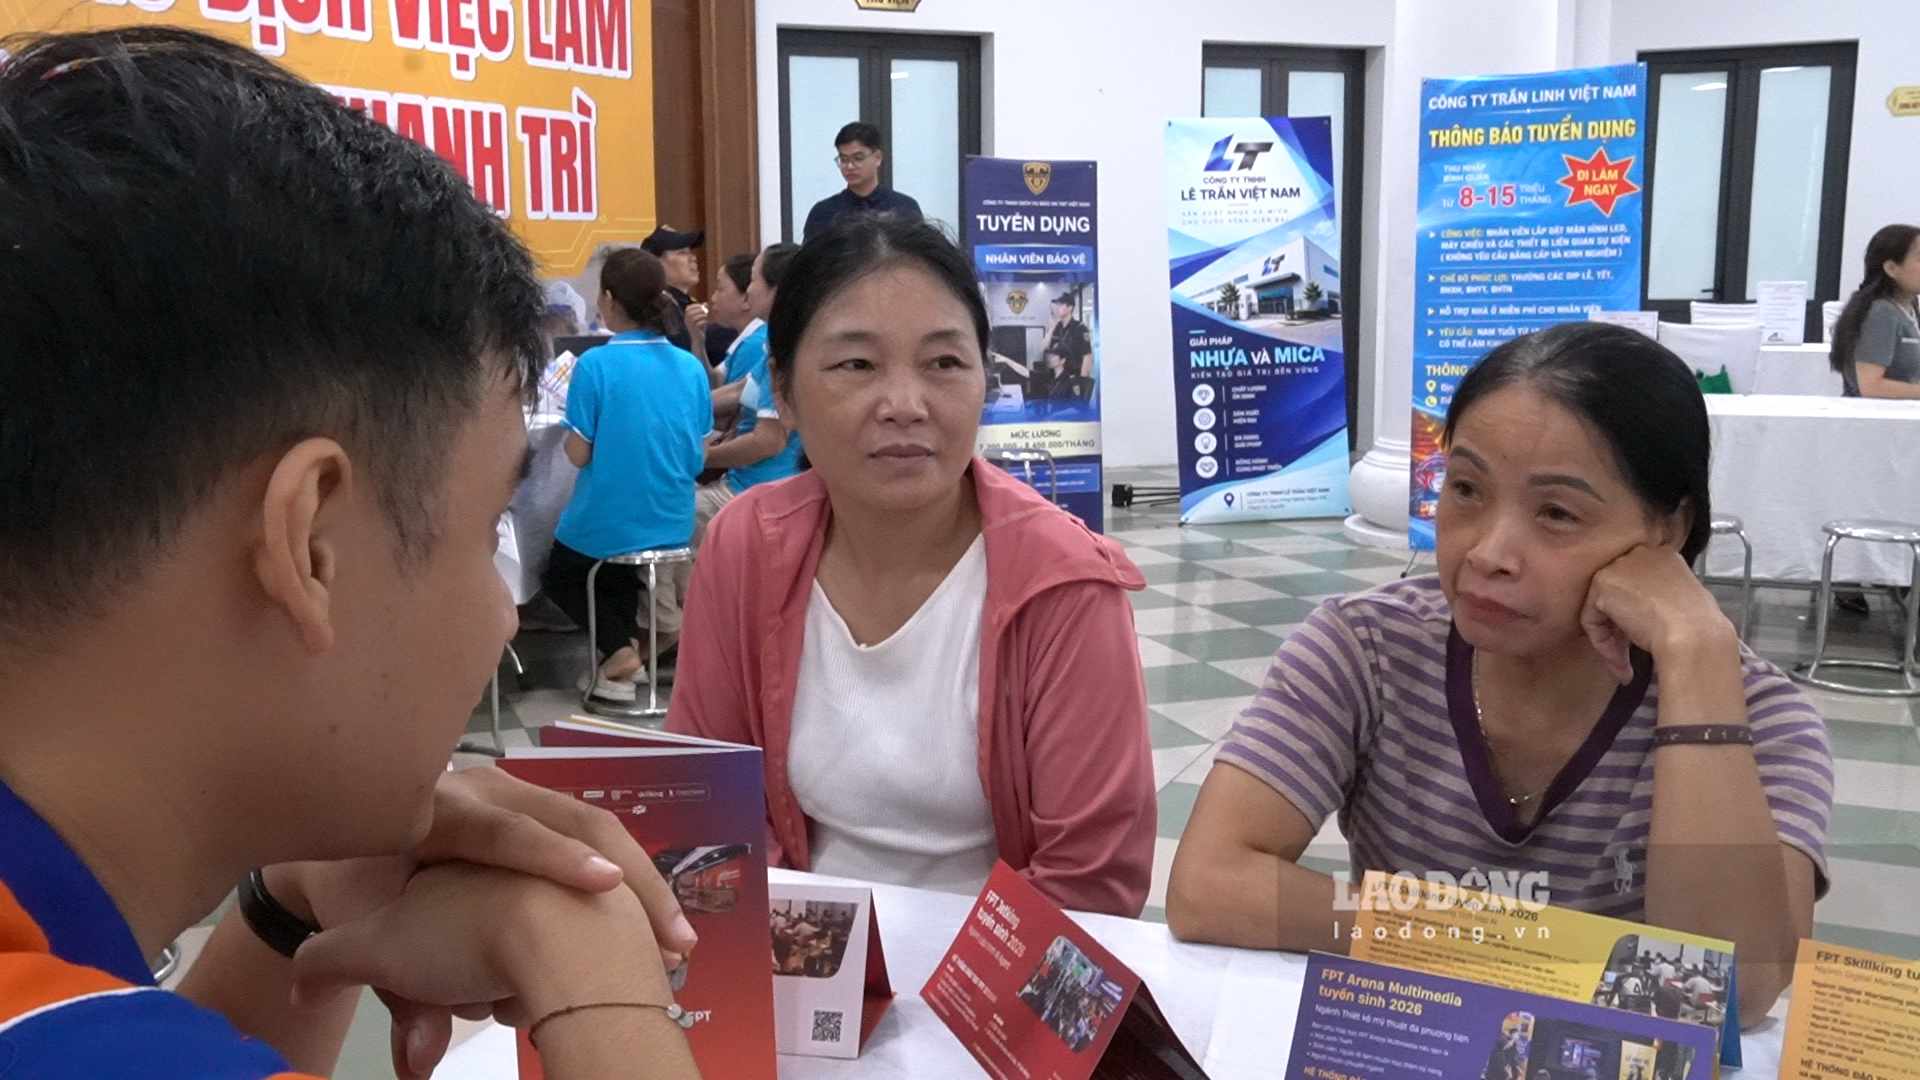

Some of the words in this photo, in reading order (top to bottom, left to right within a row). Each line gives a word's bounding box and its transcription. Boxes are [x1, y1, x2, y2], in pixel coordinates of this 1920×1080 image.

[1428, 94, 1467, 110] CÔNG
[1470, 92, 1489, 107] TY
[1531, 89, 1565, 103] LINH
[1568, 83, 1600, 103] VIỆT
[1602, 84, 1636, 100] NAM
[1429, 123, 1484, 148] THÔNG
[1489, 120, 1523, 145] BÁO
[1527, 113, 1584, 144] TUYỂN
[1587, 119, 1636, 144] DỤNG
[519, 92, 595, 215] TRÌ
[1203, 176, 1228, 184] CÔNG
[1583, 184, 1617, 197] NGAY
[1181, 186, 1197, 201] LÊ
[1239, 185, 1267, 202] VIỆT
[1270, 187, 1301, 199] NAM
[976, 212, 1035, 232] TUYỂN
[1040, 215, 1091, 236] DỤNG
[985, 252, 1017, 264] NHÂN
[1019, 252, 1044, 264] VIÊN
[1209, 336, 1233, 346] PHÁP
[1190, 346, 1248, 370] NHỰA
[1250, 347, 1271, 365] VÀ
[1274, 346, 1325, 364] MICA
[1816, 951, 1840, 963] FPT
[1843, 956, 1902, 979] Skillking
[1321, 968, 1345, 983] FPT
[1346, 973, 1385, 991] Arena
[1388, 981, 1463, 1007] Multimedia
[1319, 985, 1356, 1003] tuyển
[1357, 992, 1387, 1009] sinh
[1388, 998, 1424, 1016] 2026
